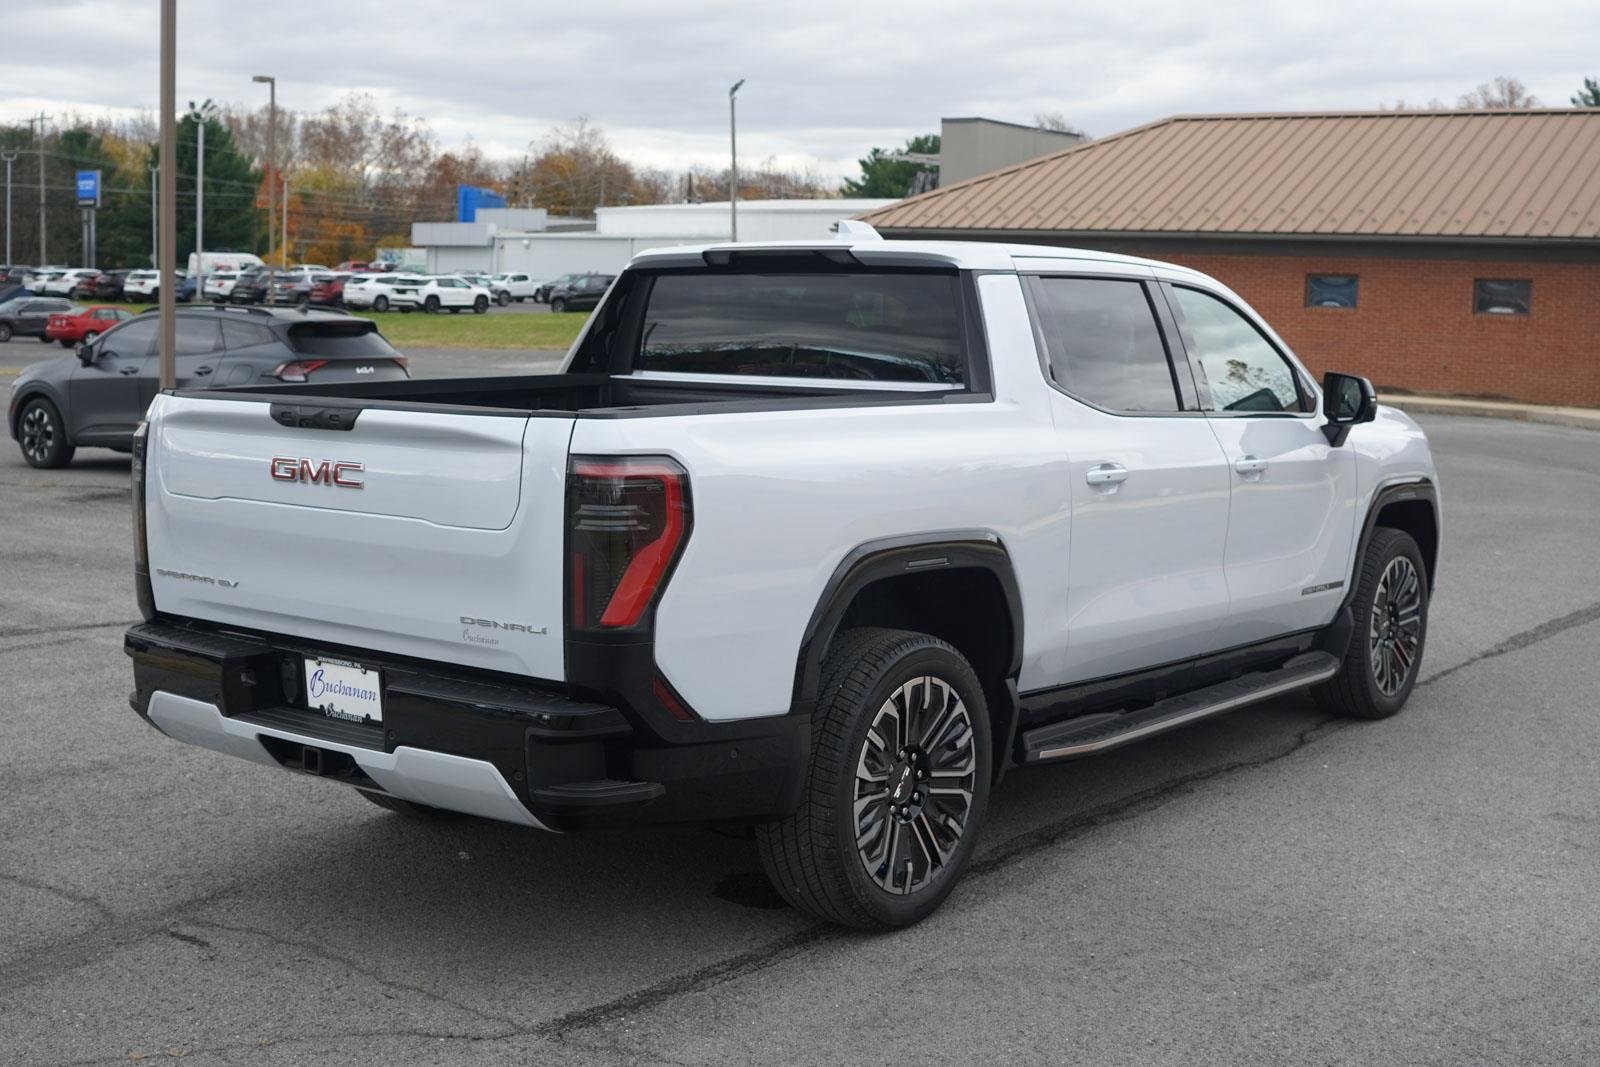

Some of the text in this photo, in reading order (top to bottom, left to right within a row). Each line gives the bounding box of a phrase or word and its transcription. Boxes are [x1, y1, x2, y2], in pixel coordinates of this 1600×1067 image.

[270, 456, 365, 490] GMC
[460, 616, 548, 636] DENALI
[462, 628, 499, 645] Buchanan
[310, 669, 377, 702] Buchanan
[325, 702, 363, 724] Buchanan
